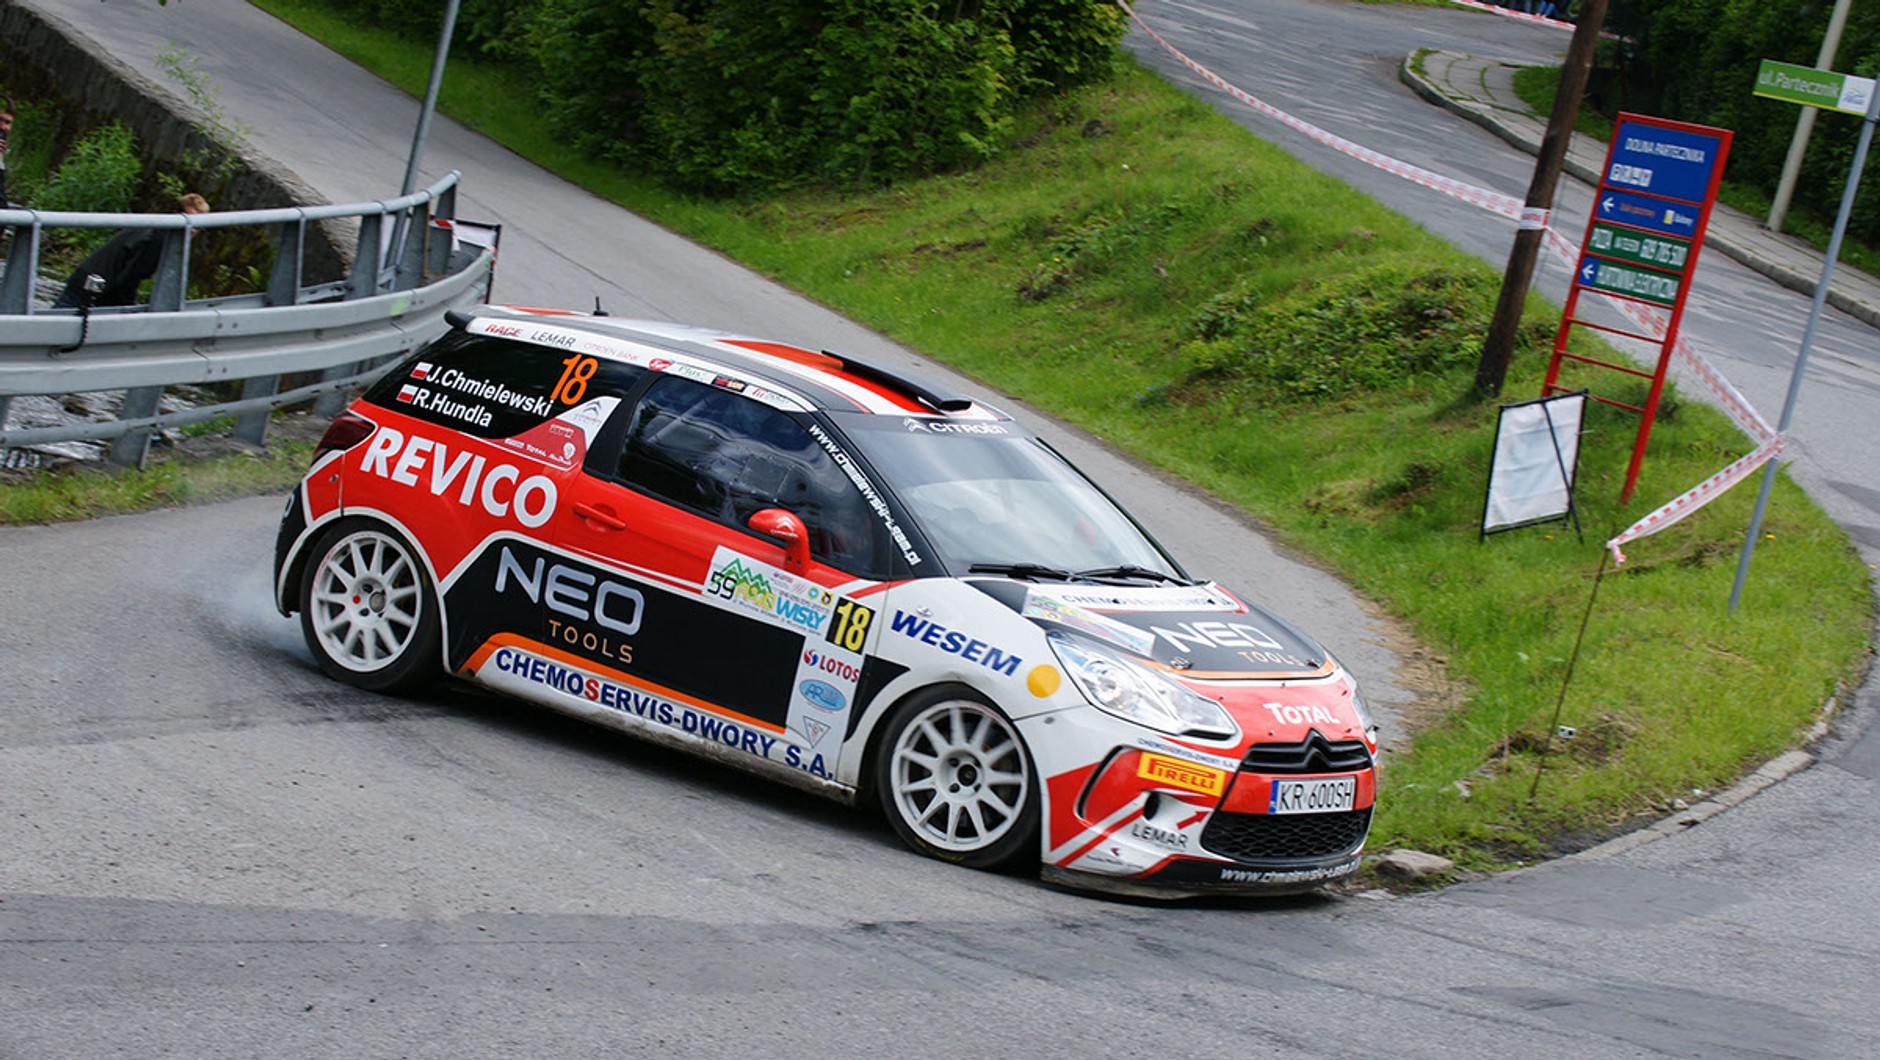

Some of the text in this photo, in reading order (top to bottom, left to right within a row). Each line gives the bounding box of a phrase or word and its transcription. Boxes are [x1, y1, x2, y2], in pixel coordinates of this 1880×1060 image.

[530, 330, 577, 349] LEMAR
[425, 365, 555, 418] J.Chmielewski
[550, 353, 599, 405] 18
[412, 388, 494, 428] R.Hundla
[360, 426, 558, 529] REVICO
[494, 546, 645, 636] NEO
[707, 570, 737, 601] 59
[548, 618, 634, 665] TOOLS
[833, 601, 872, 652] 18
[890, 610, 1023, 677] WESEM
[1150, 620, 1284, 654] NEO
[819, 655, 861, 683] LOTOS
[1238, 650, 1305, 668] TOOLS
[495, 649, 834, 781] CHEMOSERVIS-DWORY S.A.
[1147, 758, 1217, 790] PIRELLI
[1278, 781, 1352, 811] KR 600SH
[1131, 822, 1189, 848] LEMAR
